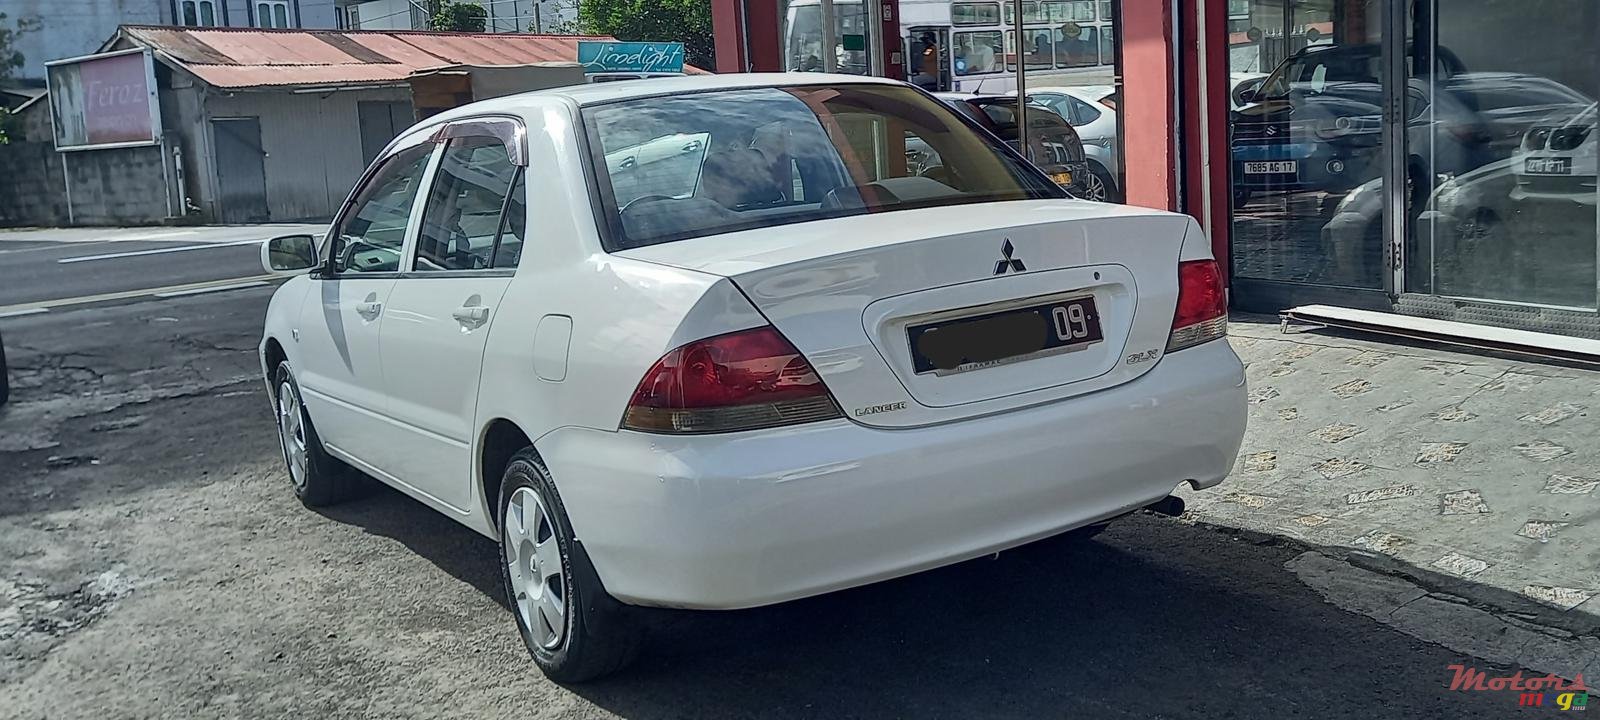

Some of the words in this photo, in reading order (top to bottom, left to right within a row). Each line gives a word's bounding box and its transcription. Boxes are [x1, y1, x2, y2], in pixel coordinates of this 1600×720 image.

[583, 43, 682, 73] Limelight
[87, 80, 144, 112] Feroz
[1247, 162, 1268, 173] 7685
[1269, 162, 1280, 172] AG
[1283, 162, 1293, 172] 17
[1052, 303, 1088, 341] 09
[1126, 348, 1159, 365] GLX
[854, 400, 907, 417] LANCER
